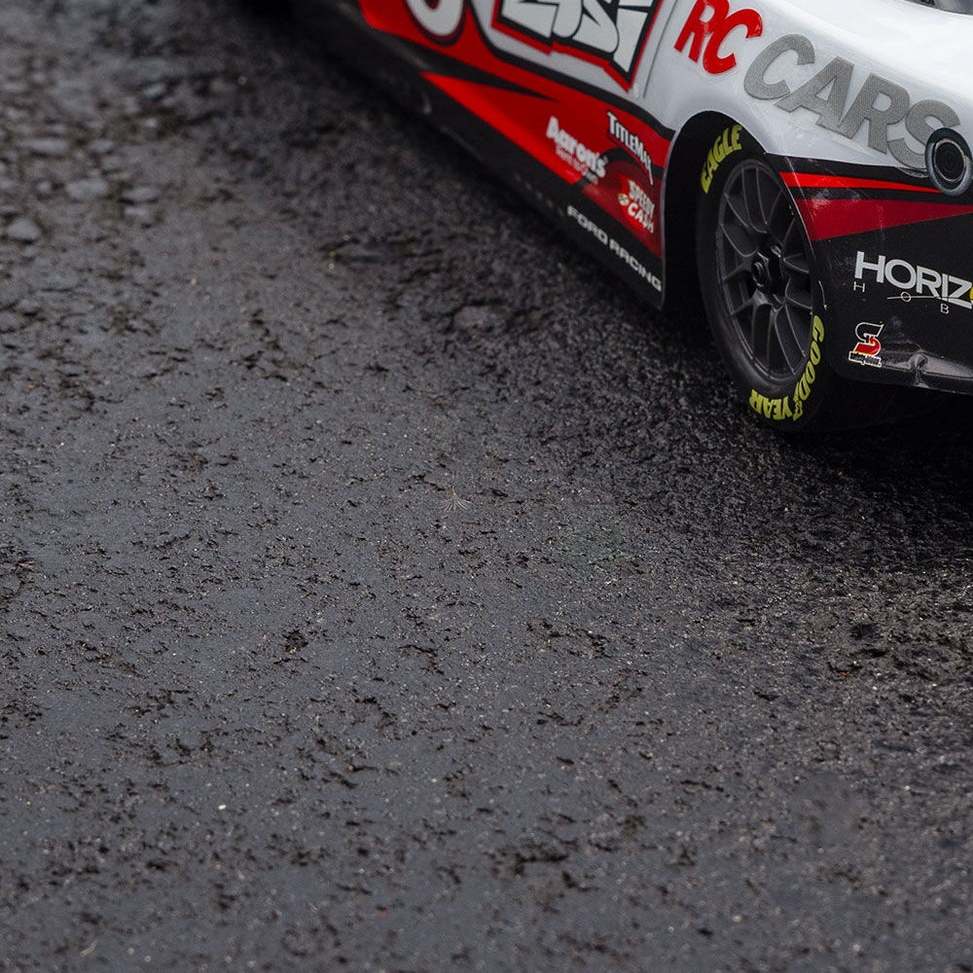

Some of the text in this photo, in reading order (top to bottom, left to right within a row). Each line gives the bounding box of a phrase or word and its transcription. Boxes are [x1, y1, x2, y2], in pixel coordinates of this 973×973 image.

[743, 33, 961, 170] CARS
[701, 123, 743, 194] EAGLE
[566, 205, 662, 292] FORD RACING
